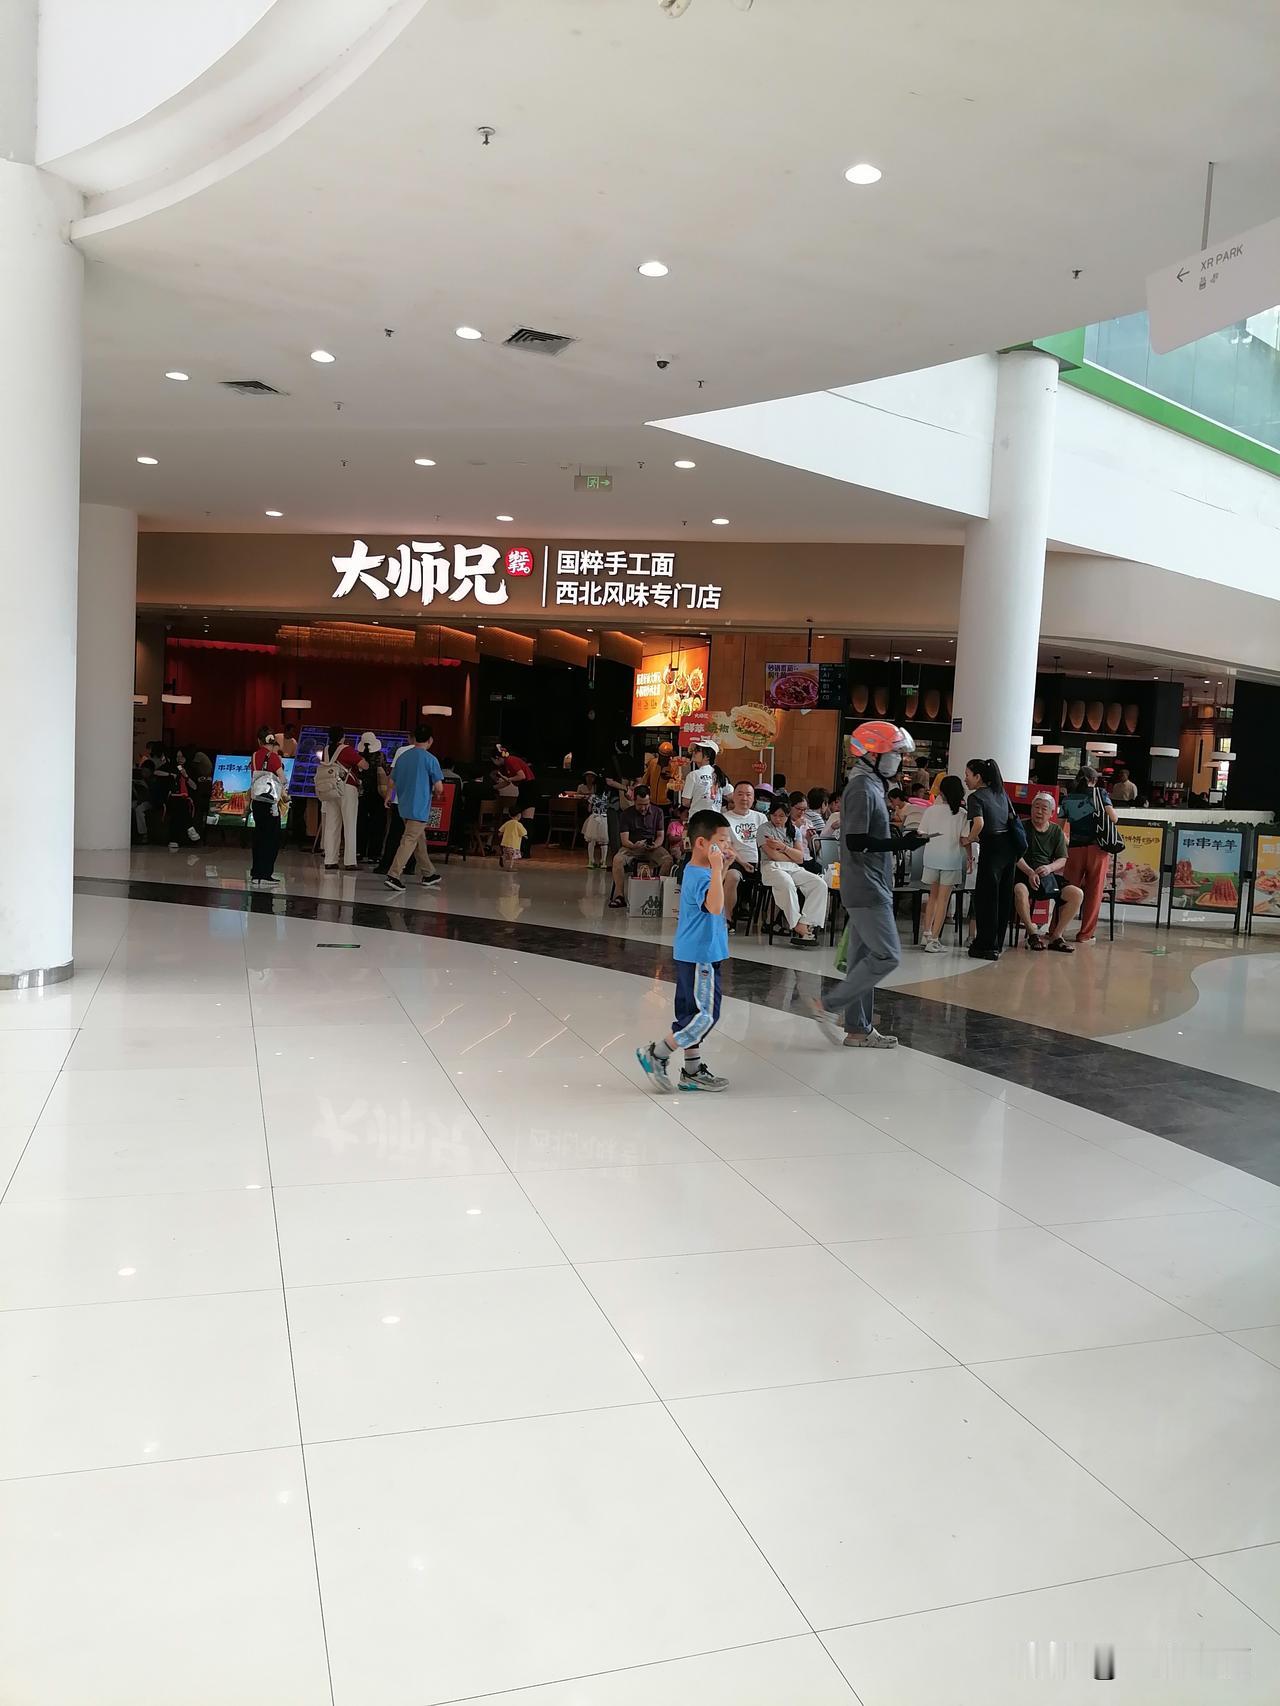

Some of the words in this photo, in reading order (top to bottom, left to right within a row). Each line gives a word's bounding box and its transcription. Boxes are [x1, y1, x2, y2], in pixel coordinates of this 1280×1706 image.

[1200, 257, 1214, 272] XR
[1215, 243, 1244, 265] PARK
[331, 539, 509, 606] 大师兄
[557, 549, 675, 577] 国粹手工面
[556, 581, 722, 610] 西北风味专门店
[1182, 837, 1237, 851] 串串羊羊
